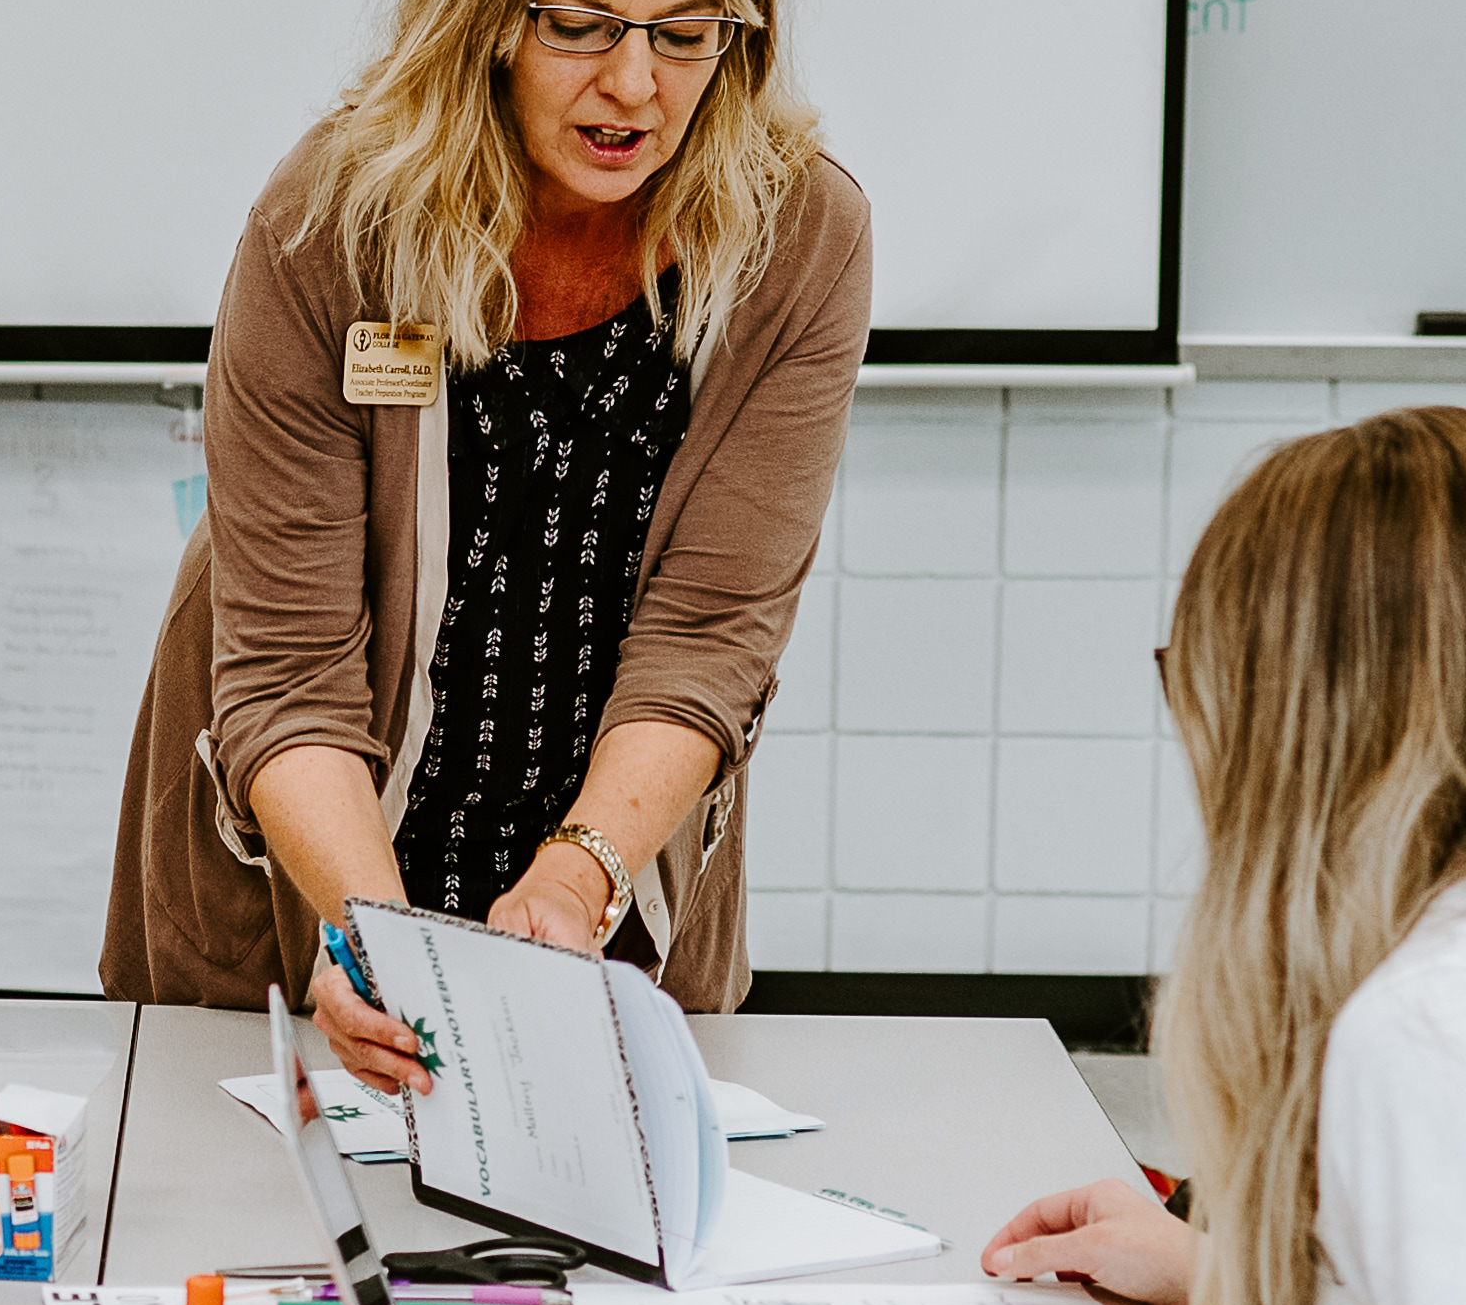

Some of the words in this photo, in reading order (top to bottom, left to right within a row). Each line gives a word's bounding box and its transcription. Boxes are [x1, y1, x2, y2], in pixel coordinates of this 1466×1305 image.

[351, 363, 384, 374] Elizabeth
[372, 341, 400, 349] COLLEE
[419, 927, 467, 1049] NOTEBOOK!
[456, 1051, 491, 1197] VOCABULARY
